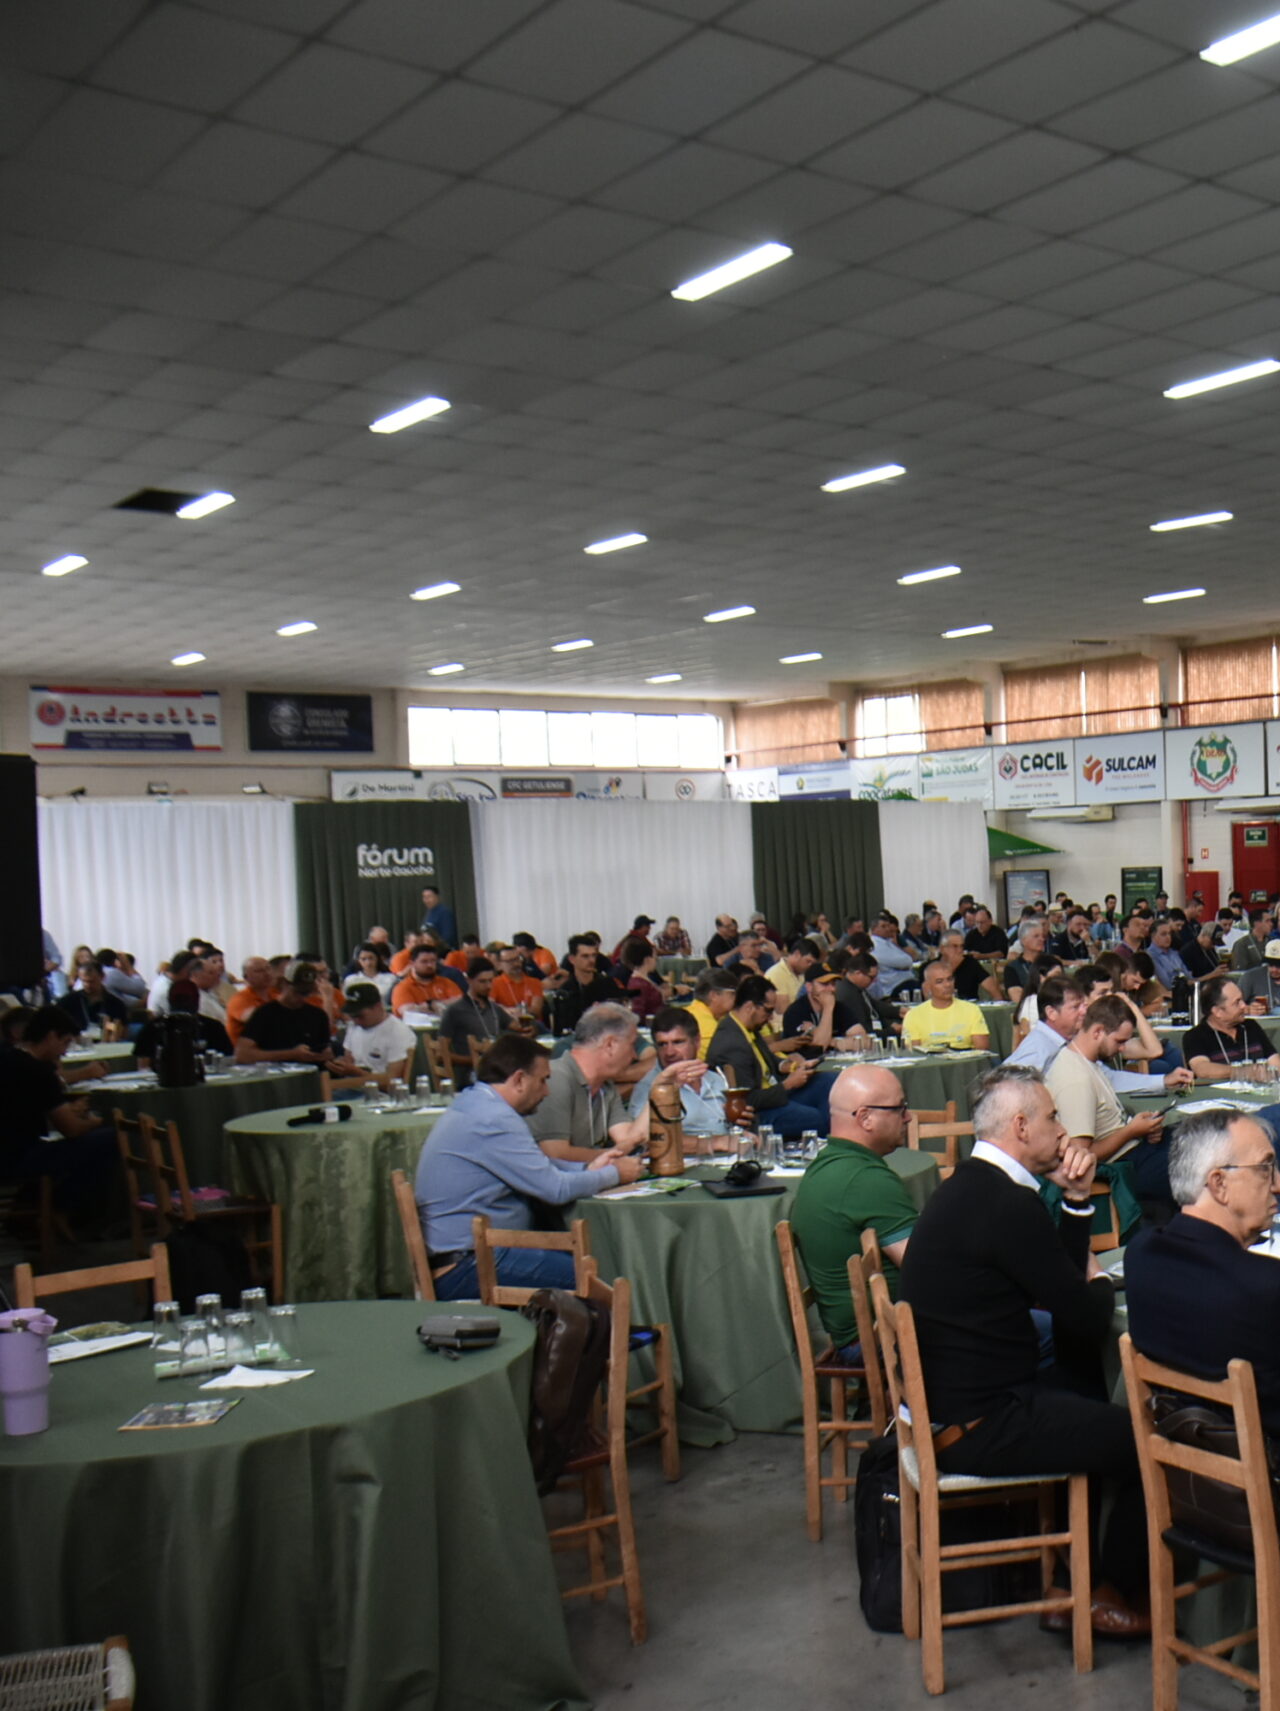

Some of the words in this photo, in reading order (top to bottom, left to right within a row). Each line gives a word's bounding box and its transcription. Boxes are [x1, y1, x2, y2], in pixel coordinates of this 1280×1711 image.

[1020, 751, 1068, 773] CACIL
[1105, 754, 1157, 773] SULCAM
[357, 843, 434, 866] fórum
